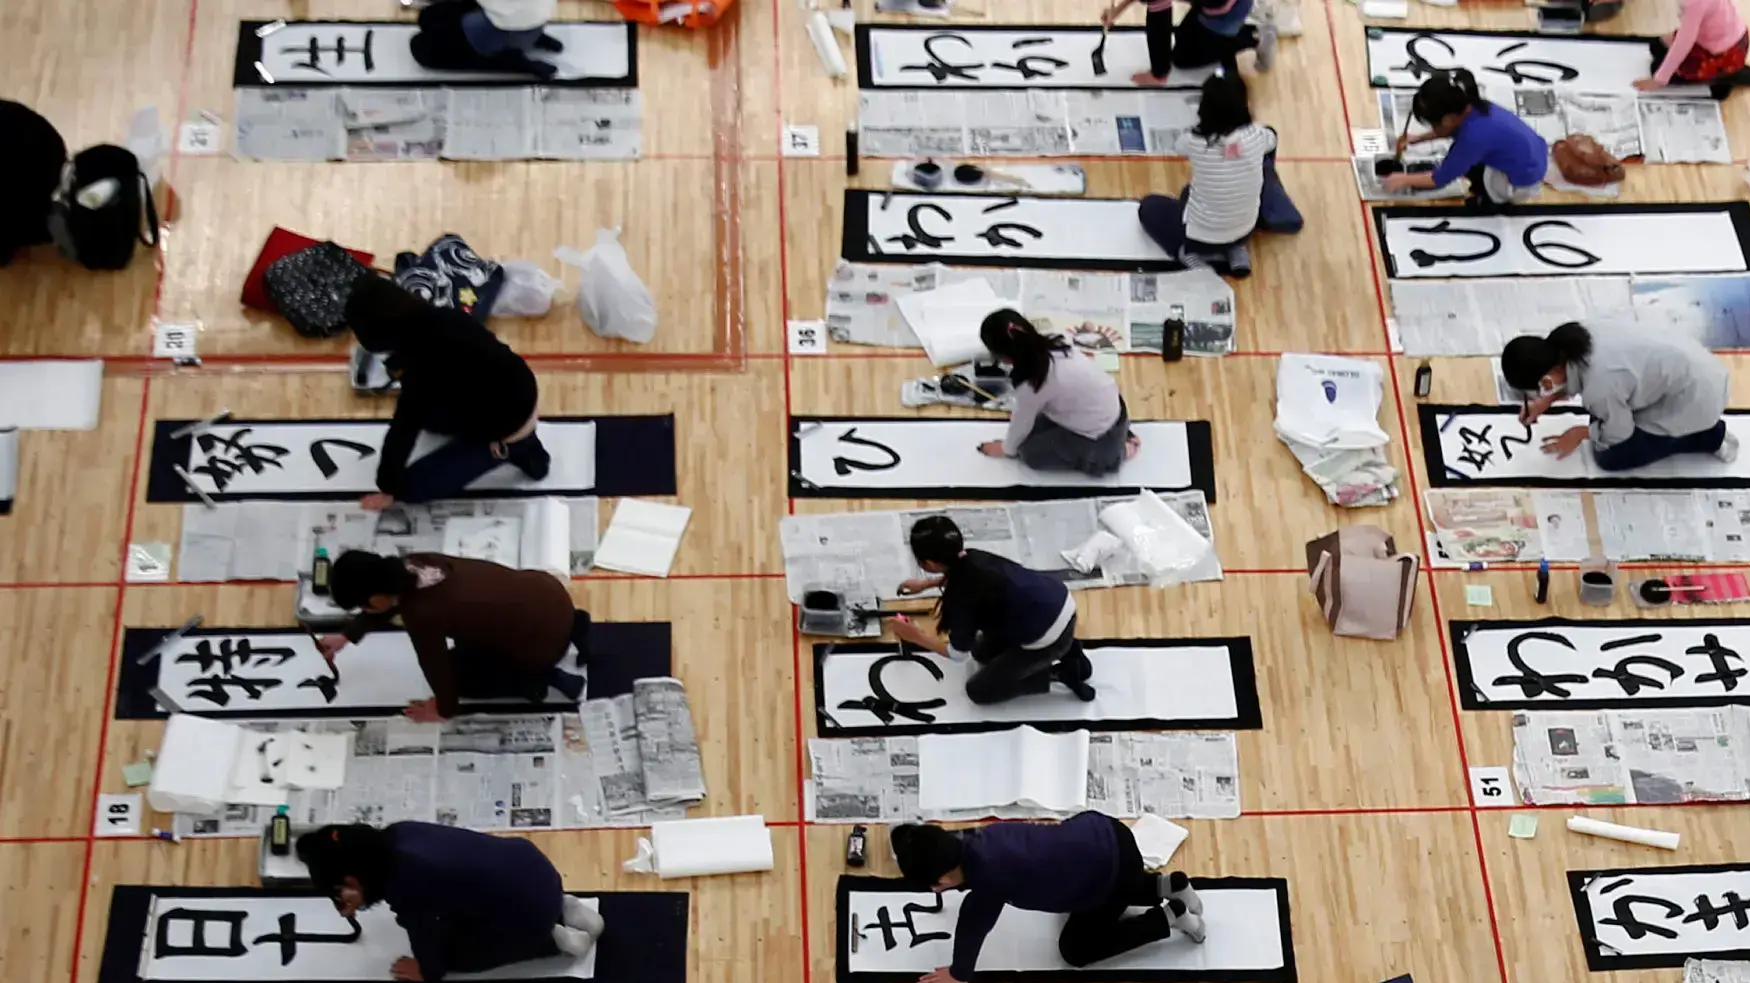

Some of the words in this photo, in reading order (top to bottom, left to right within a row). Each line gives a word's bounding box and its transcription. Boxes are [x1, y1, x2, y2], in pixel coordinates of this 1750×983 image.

[1409, 219, 1600, 268] ひの
[798, 328, 817, 347] 36
[833, 655, 946, 725] わ
[1481, 776, 1502, 797] 51
[107, 803, 131, 826] 18
